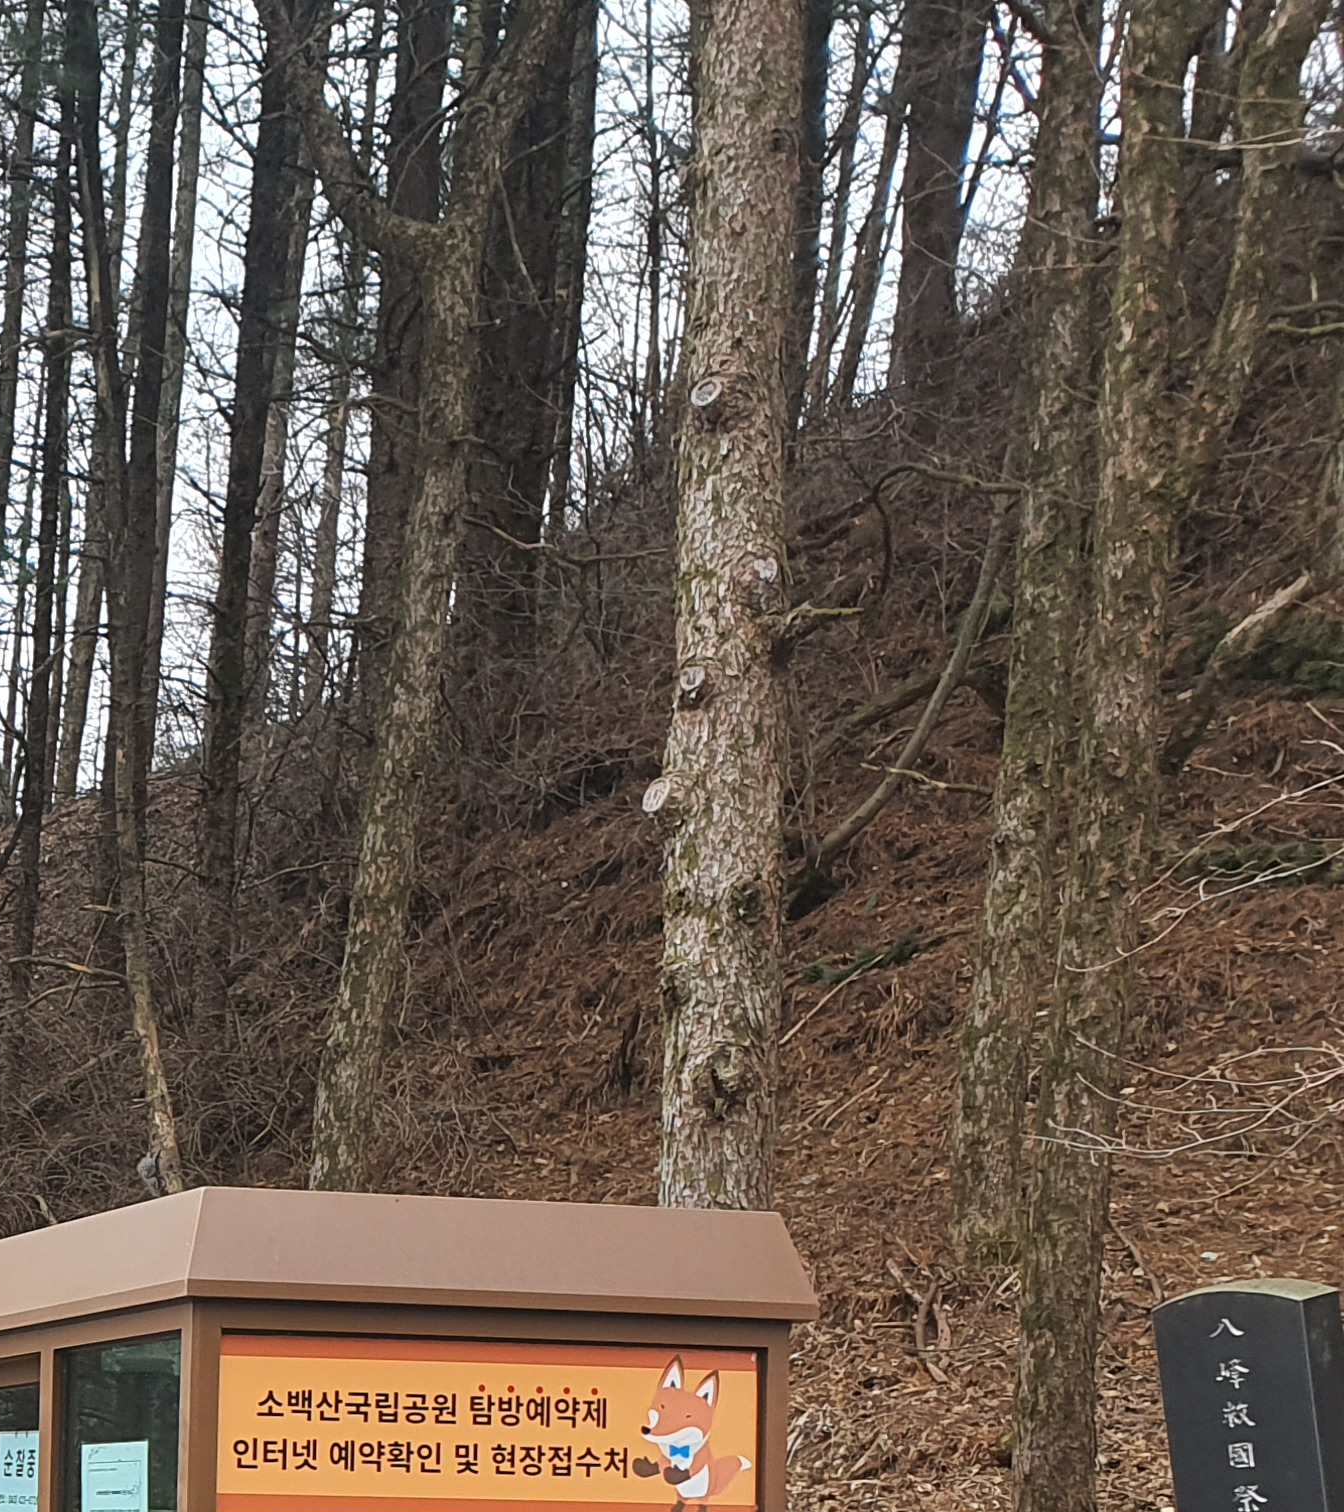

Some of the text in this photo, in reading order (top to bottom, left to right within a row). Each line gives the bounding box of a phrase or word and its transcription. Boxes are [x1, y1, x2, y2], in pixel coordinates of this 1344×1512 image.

[256, 1388, 608, 1429] 소백산국립공원 탐방예약제
[3, 1448, 36, 1478] 순찰중
[232, 1437, 630, 1480] 인터넷 예약확인 및 현장접수처
